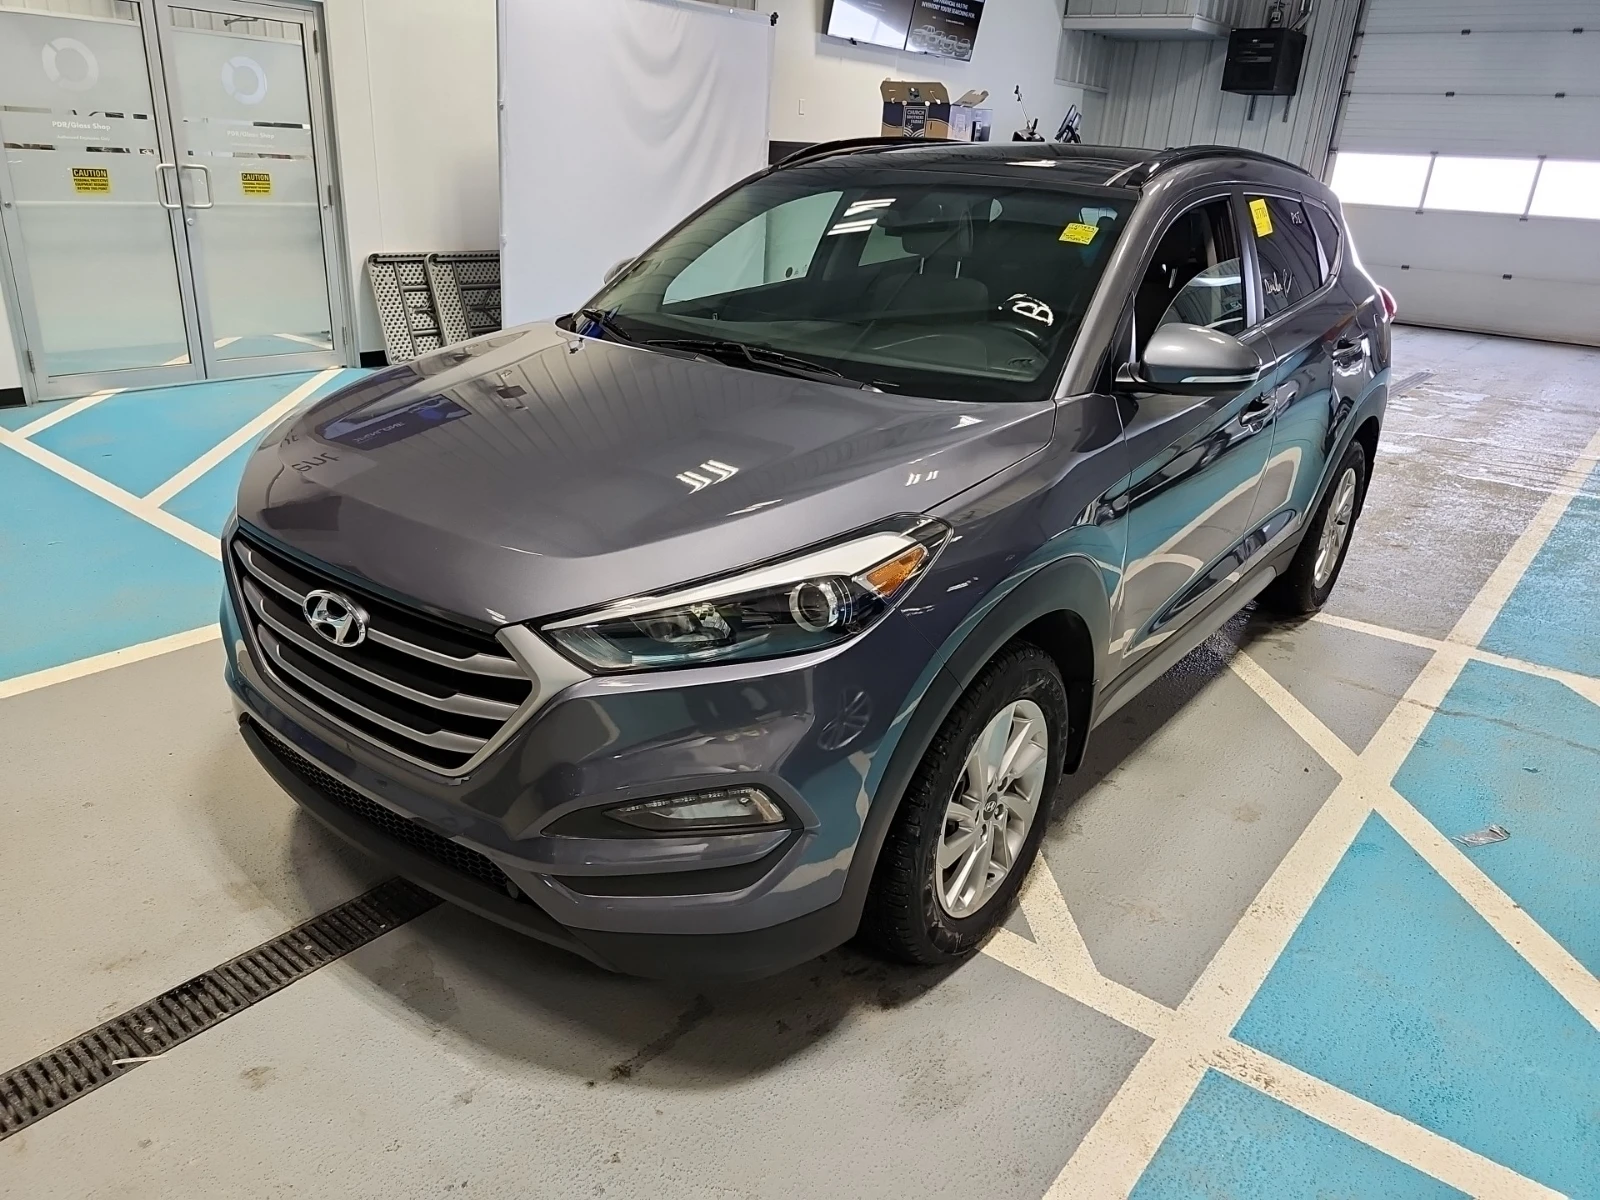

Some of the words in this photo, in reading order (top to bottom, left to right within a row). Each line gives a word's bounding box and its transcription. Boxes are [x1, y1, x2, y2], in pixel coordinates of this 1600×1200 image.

[52, 120, 91, 129] PDR/Glass
[92, 122, 111, 132] Shop
[259, 132, 275, 140] Shop
[73, 169, 107, 177] CAUTION
[242, 173, 269, 181] CAUTION
